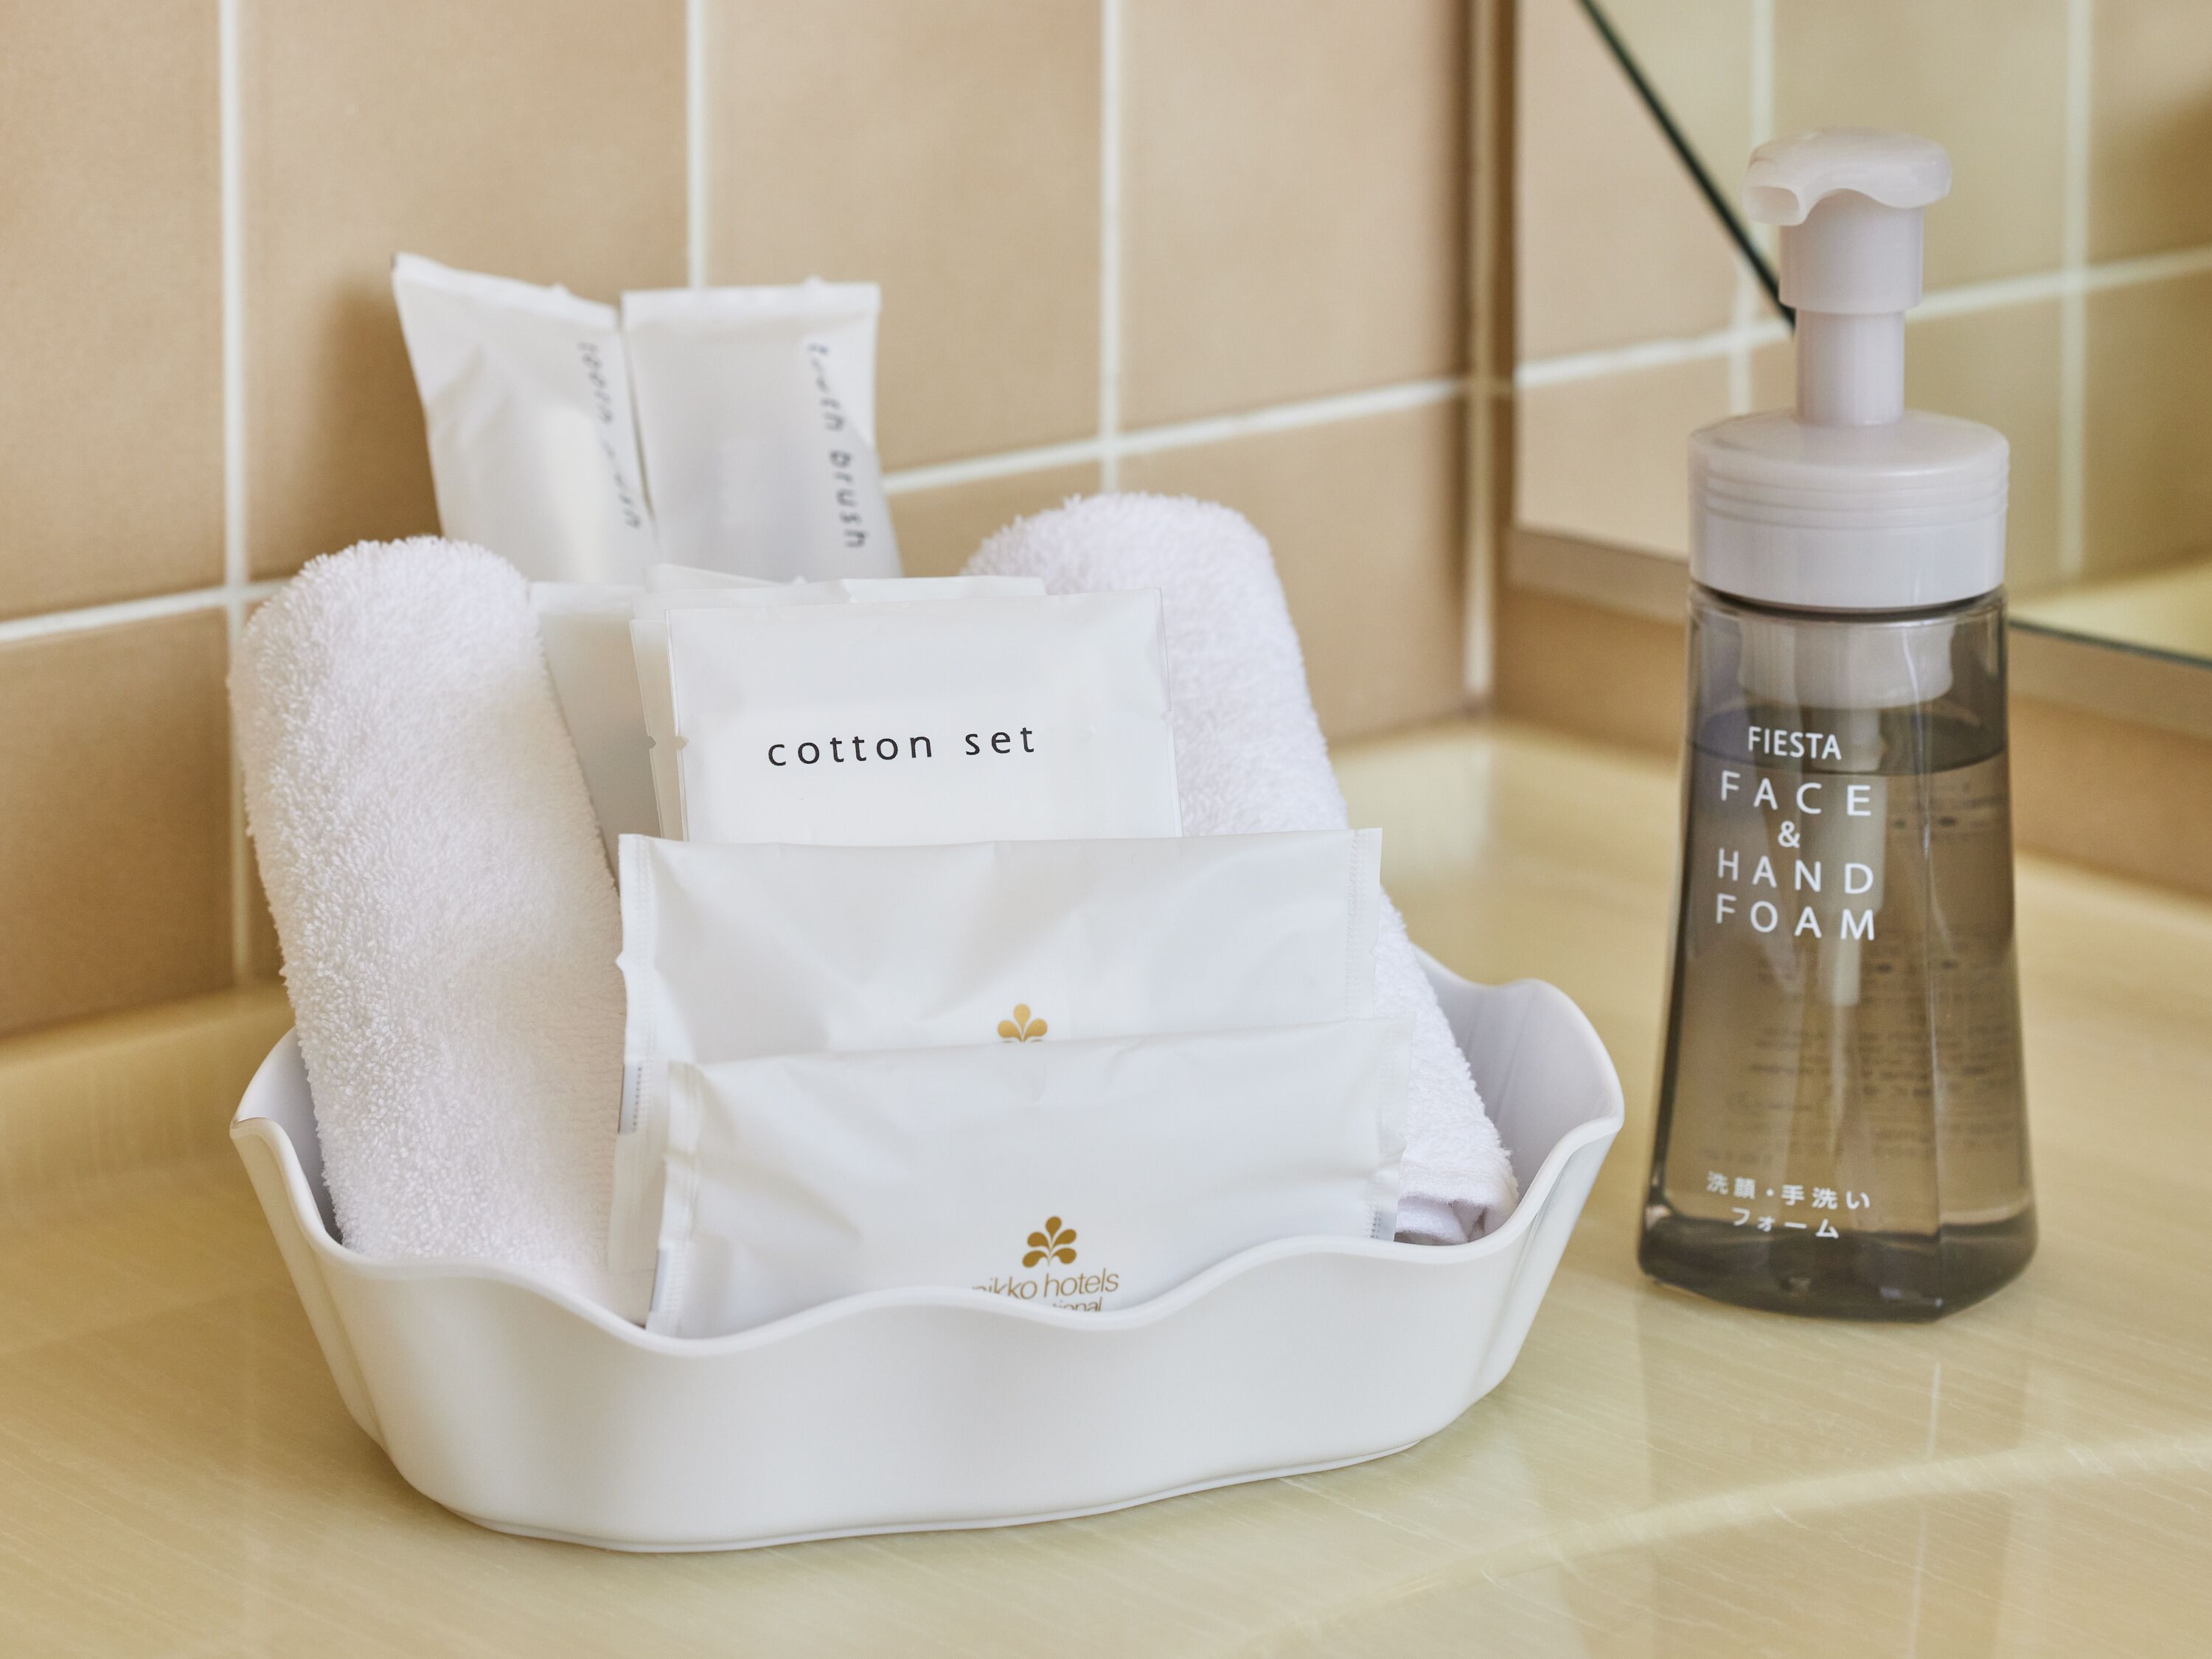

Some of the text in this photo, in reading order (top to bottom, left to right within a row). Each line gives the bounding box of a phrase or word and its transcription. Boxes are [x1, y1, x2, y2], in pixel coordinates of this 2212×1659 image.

[830, 449, 869, 549] brush
[768, 727, 1034, 766] cotton set
[1747, 726, 1842, 760] FIESTA
[1721, 770, 1871, 816] FACE
[1778, 820, 1801, 848] &
[1717, 848, 1874, 894] HAND
[1716, 893, 1875, 941] FOAM
[1706, 1171, 1871, 1210] 洗顔・手洗い
[1731, 1206, 1839, 1239] フォーム
[971, 1267, 1119, 1300] ikko hotels
